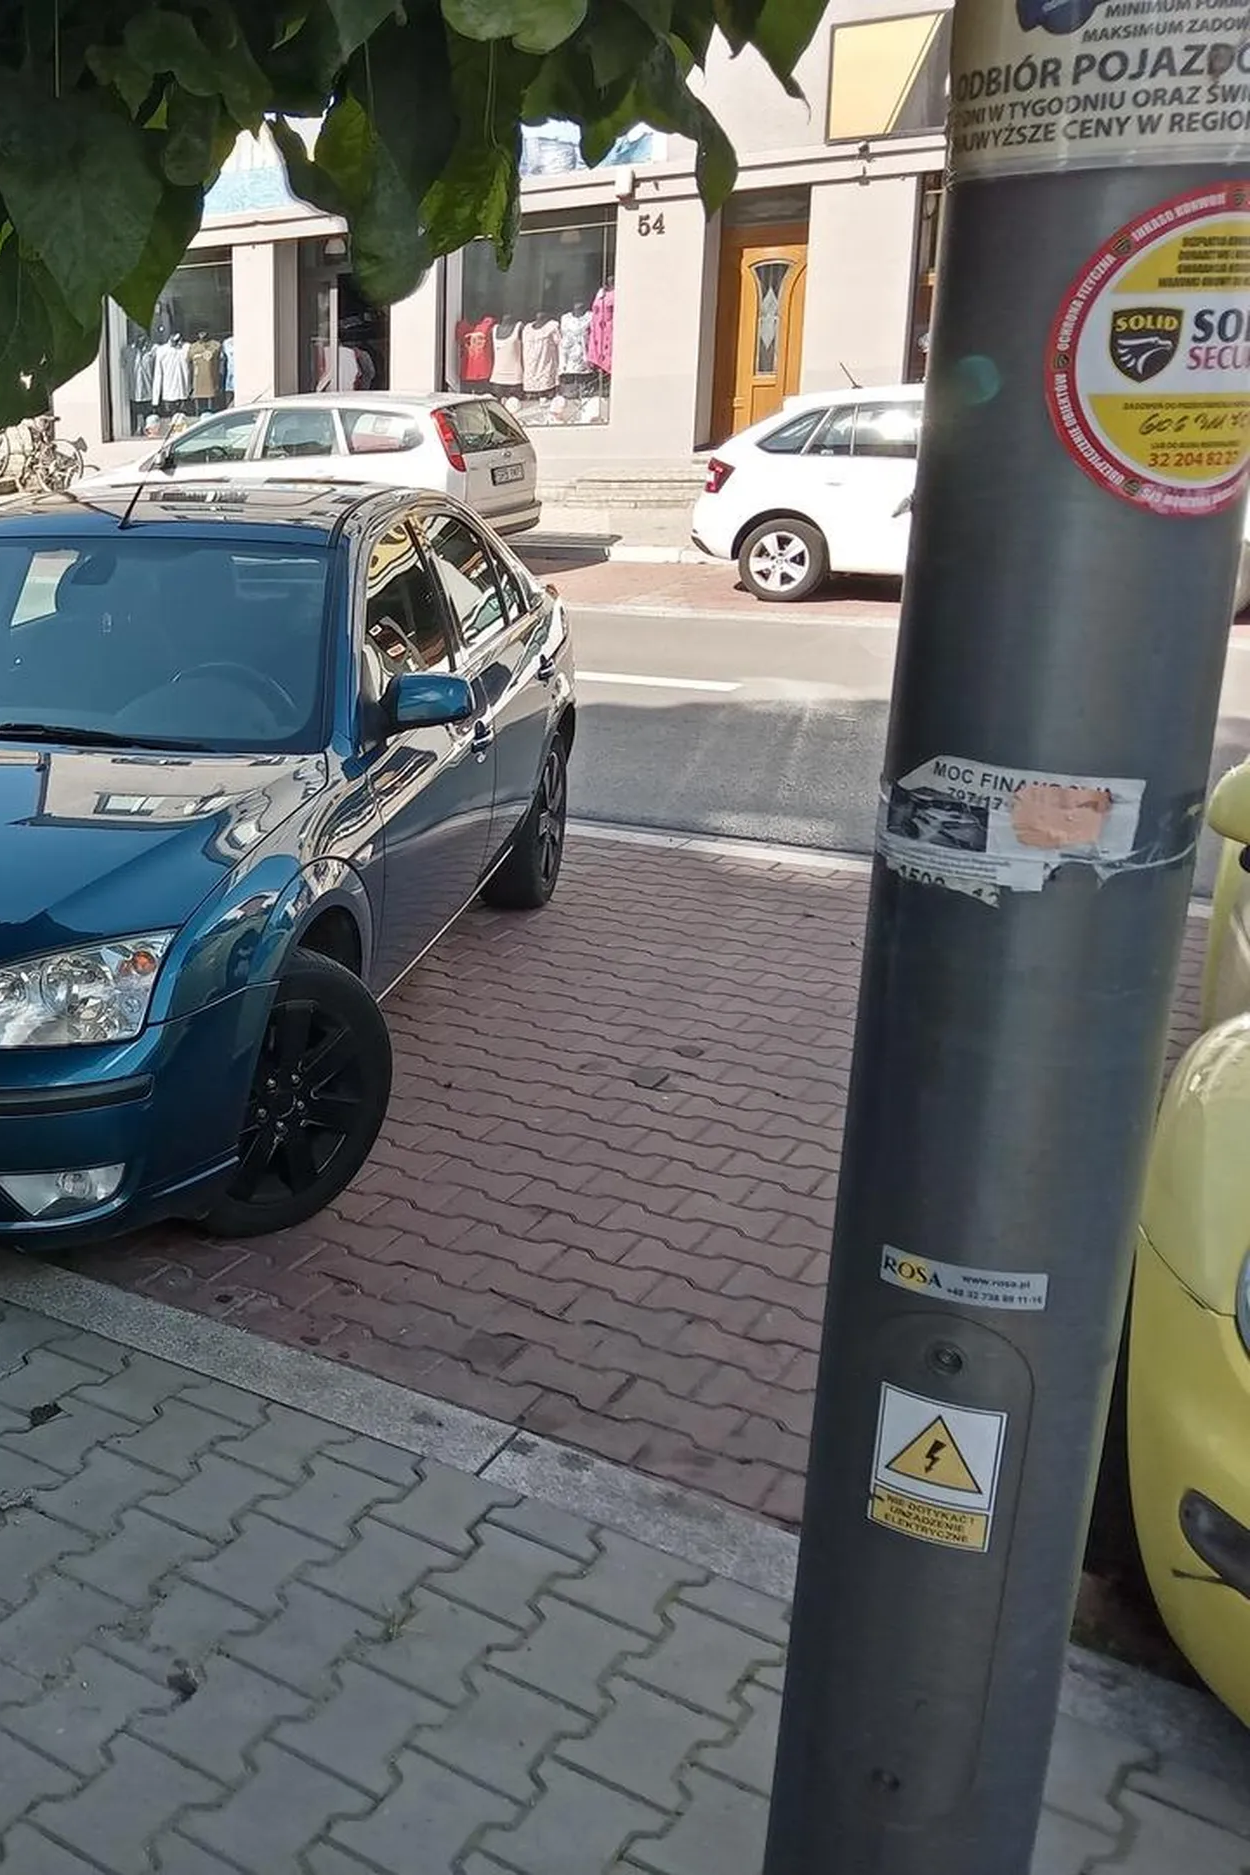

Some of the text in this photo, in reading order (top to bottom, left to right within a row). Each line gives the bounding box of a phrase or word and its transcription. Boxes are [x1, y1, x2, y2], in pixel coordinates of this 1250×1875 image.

[1082, 20, 1183, 42] MAKSIMUM
[956, 54, 1062, 101] ODBIÓR
[989, 104, 1005, 123] W
[1009, 91, 1126, 120] TYGODNIU
[1132, 86, 1202, 108] ORAZ
[1063, 113, 1132, 141] CENY
[1138, 113, 1163, 136] W
[638, 212, 666, 237] 54
[1115, 314, 1179, 332] SOLID
[1148, 452, 1170, 467] 32
[1173, 451, 1203, 467] 204
[933, 761, 975, 784] MOC
[884, 1255, 1031, 1290] ROSA www.rosa.pl
[908, 1501, 967, 1524] DOTYKAĆ
[884, 1512, 969, 1543] ELEKTRYCZNE
